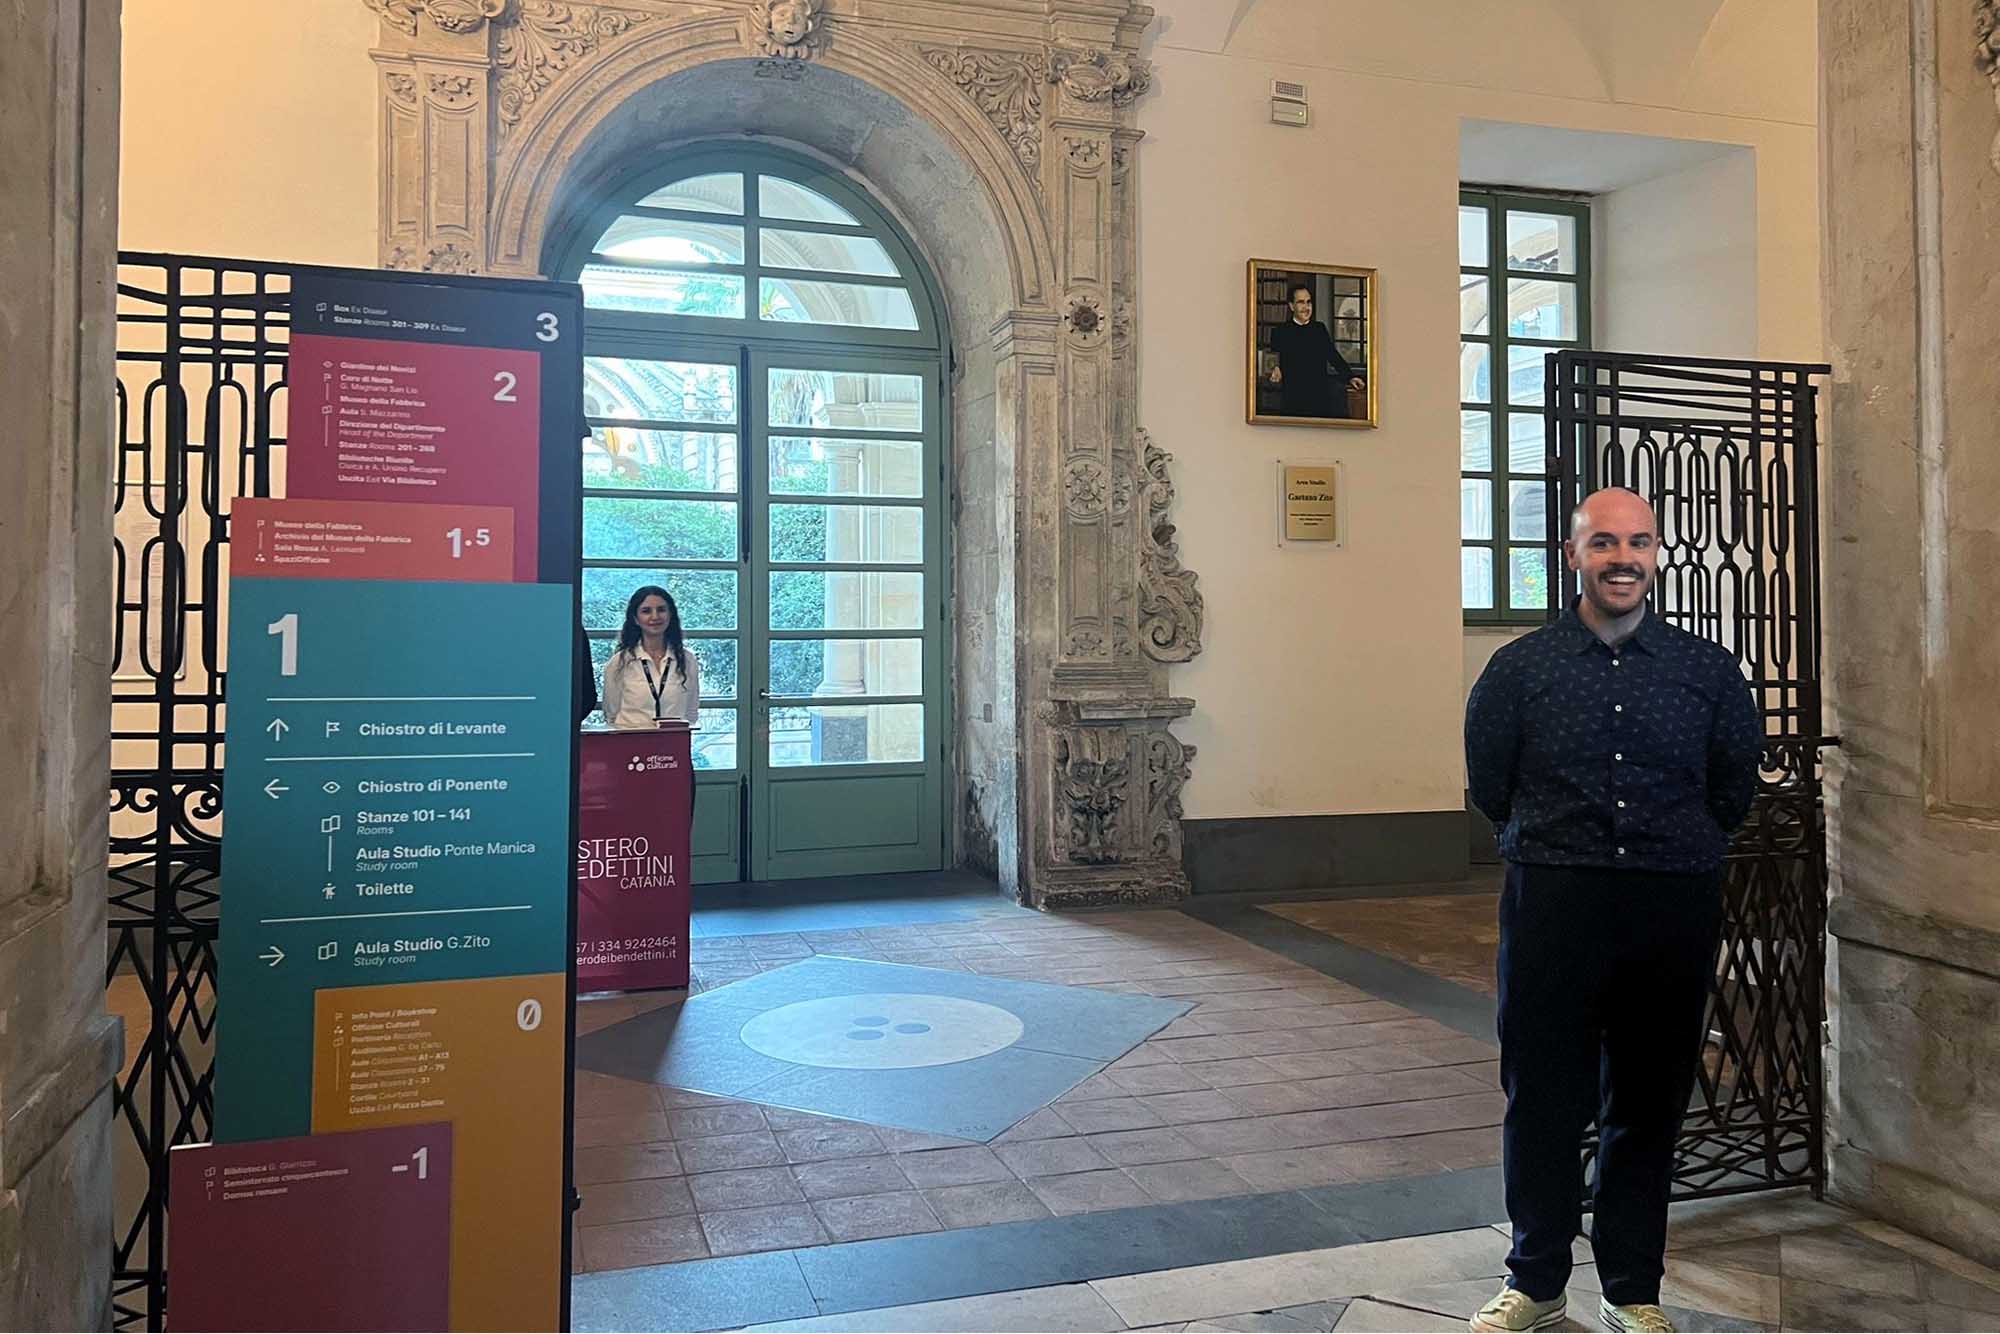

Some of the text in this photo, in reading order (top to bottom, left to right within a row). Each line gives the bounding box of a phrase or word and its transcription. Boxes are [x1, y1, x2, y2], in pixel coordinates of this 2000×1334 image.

[536, 312, 559, 341] 3
[494, 371, 517, 402] 2
[340, 395, 426, 407] Museo della Fabbrica
[447, 528, 490, 558] 1.5
[268, 614, 298, 676] 1
[359, 722, 506, 736] Chiostro di Levante
[646, 761, 678, 770] culturali
[647, 755, 674, 764] officine
[358, 779, 508, 793] Chiostro di Ponente
[357, 811, 409, 824] Stanze
[412, 810, 434, 822] 101
[450, 808, 471, 820] 141
[357, 825, 394, 836] Rooms
[356, 842, 536, 860] Aula Studio Ponte Manica
[356, 860, 418, 873] Study room
[356, 883, 414, 896] Toilette
[620, 875, 676, 890] CATANIA
[354, 936, 490, 954] Aula Studio G.Zito
[598, 940, 620, 952] 334
[624, 936, 676, 950] 9242464
[354, 954, 416, 967] Study room
[517, 998, 542, 1031] 0
